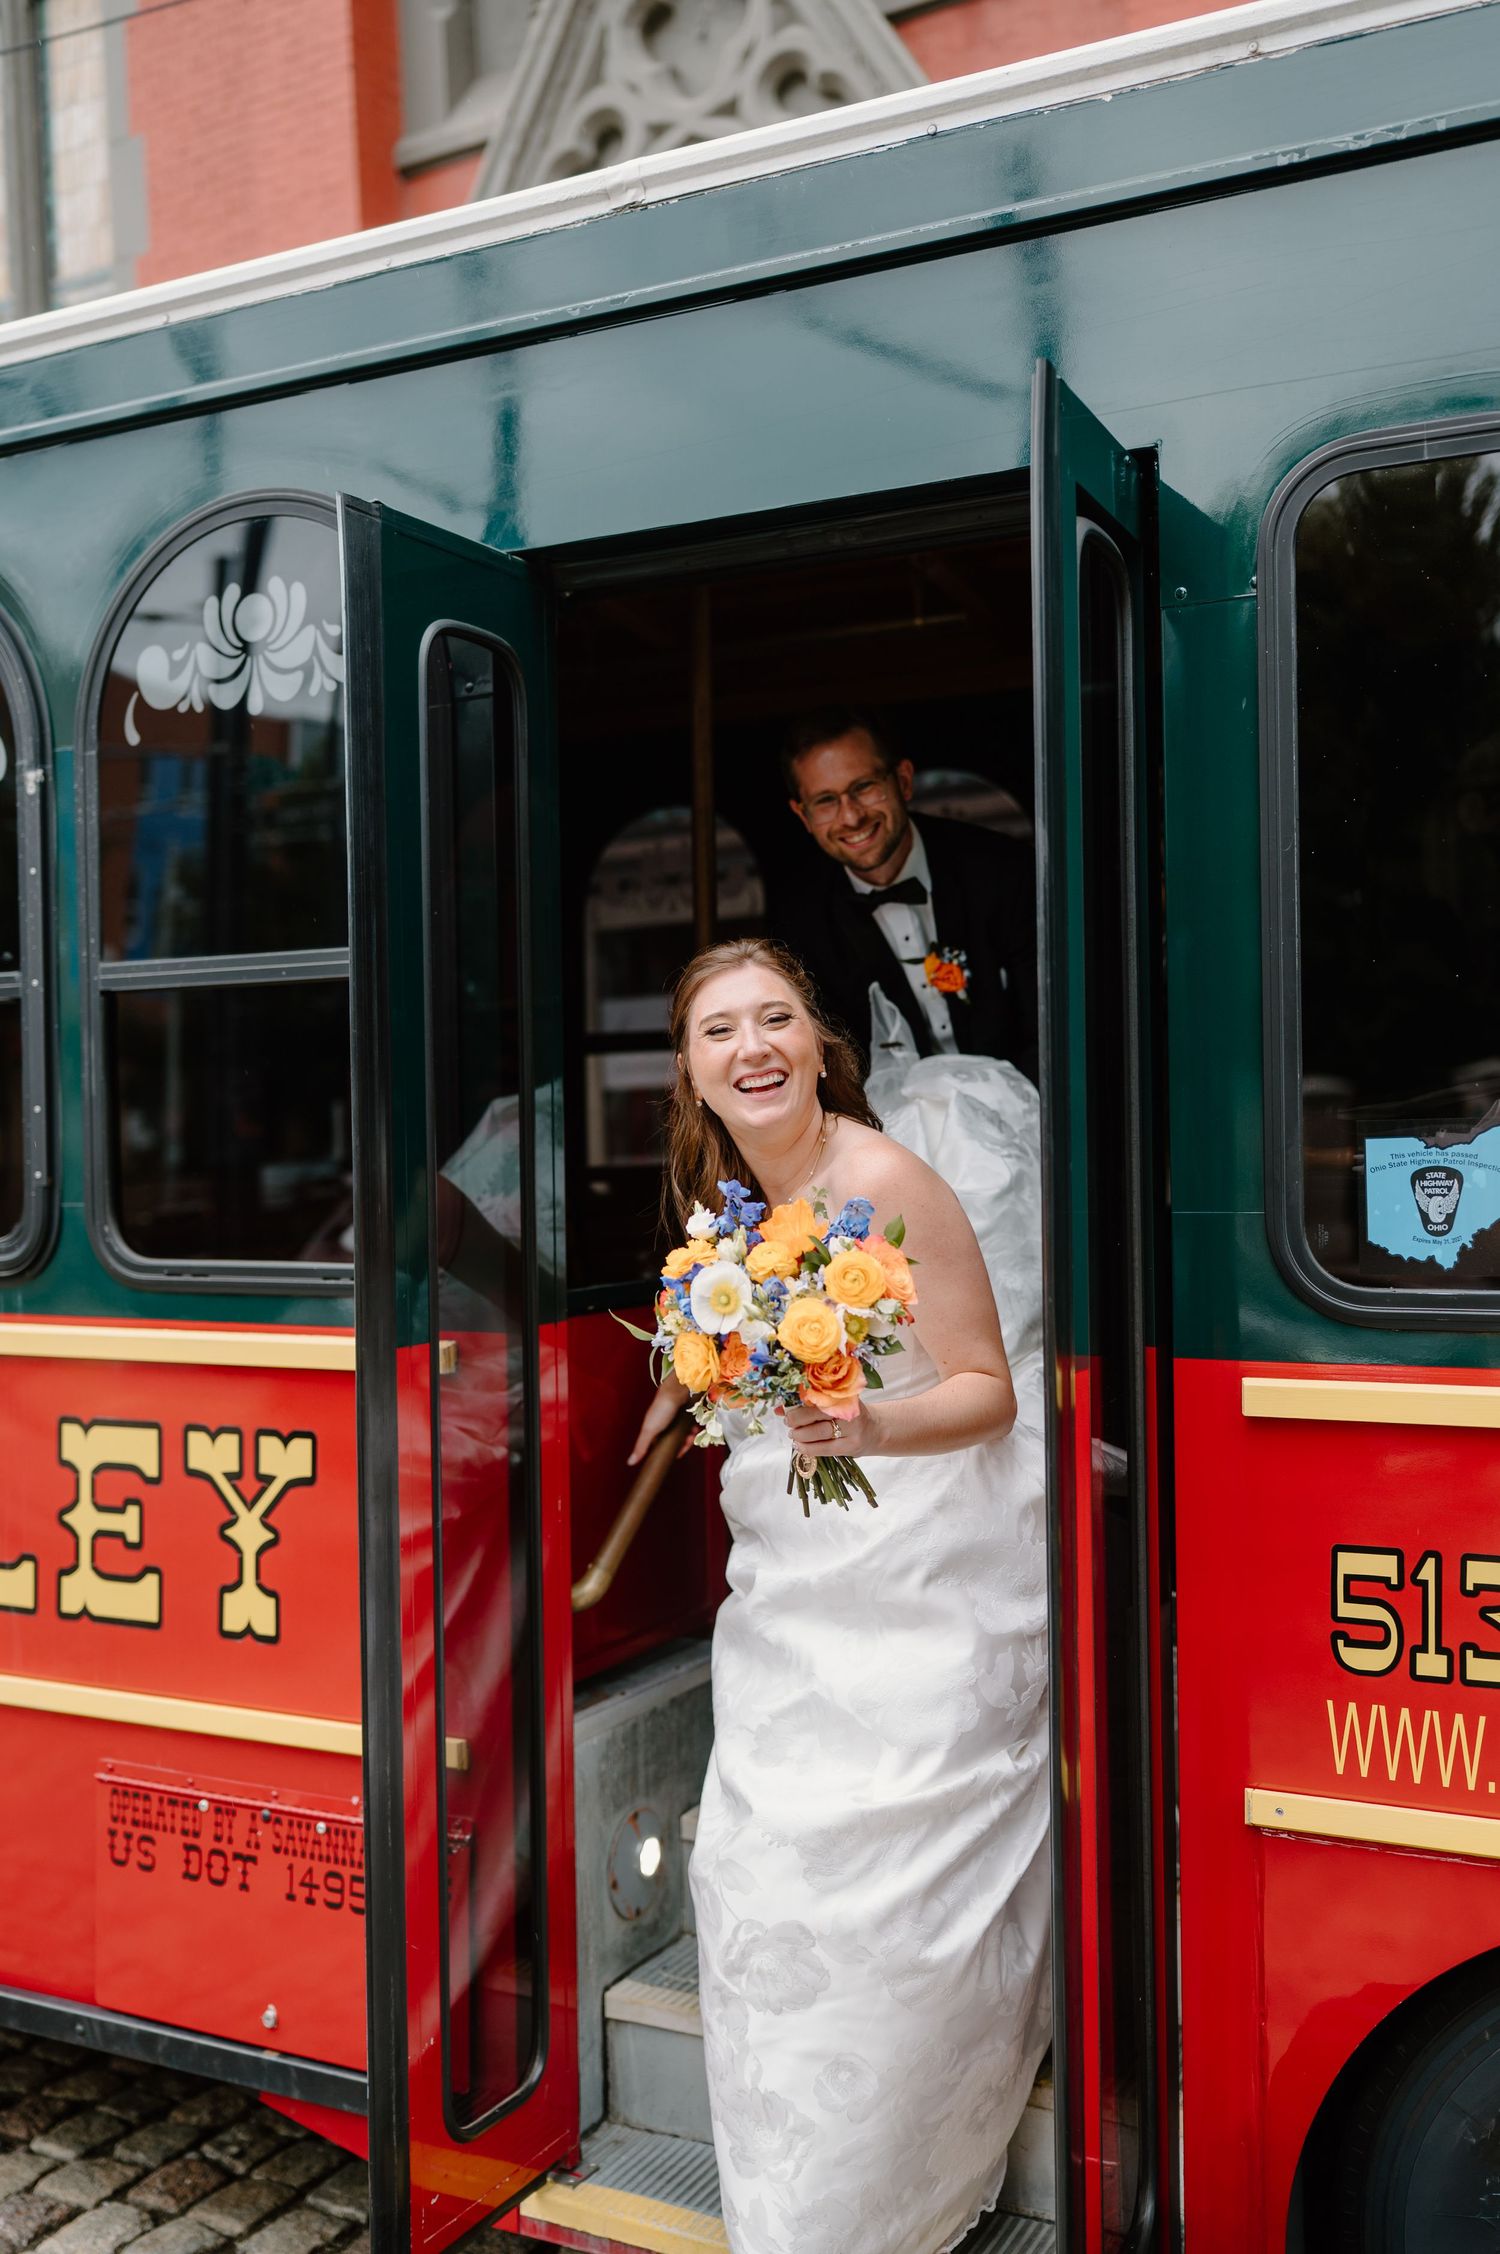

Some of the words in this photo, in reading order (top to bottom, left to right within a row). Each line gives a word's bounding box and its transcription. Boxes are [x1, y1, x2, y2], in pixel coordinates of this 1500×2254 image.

[1407, 1150, 1433, 1158] vehicle
[1451, 1151, 1478, 1160] passed
[1370, 1165, 1387, 1173] Ohio
[1388, 1160, 1408, 1169] State
[1410, 1158, 1441, 1166] Highway
[1443, 1157, 1465, 1165] Patrol
[1425, 1171, 1447, 1180] STATE
[1424, 1187, 1450, 1195] PATROL
[1427, 1223, 1449, 1231] OHIO
[110, 1787, 202, 1839] OPERATED
[213, 1805, 237, 1845] BY
[245, 1811, 260, 1850] A
[107, 1827, 156, 1872] US
[182, 1842, 258, 1892] DOT
